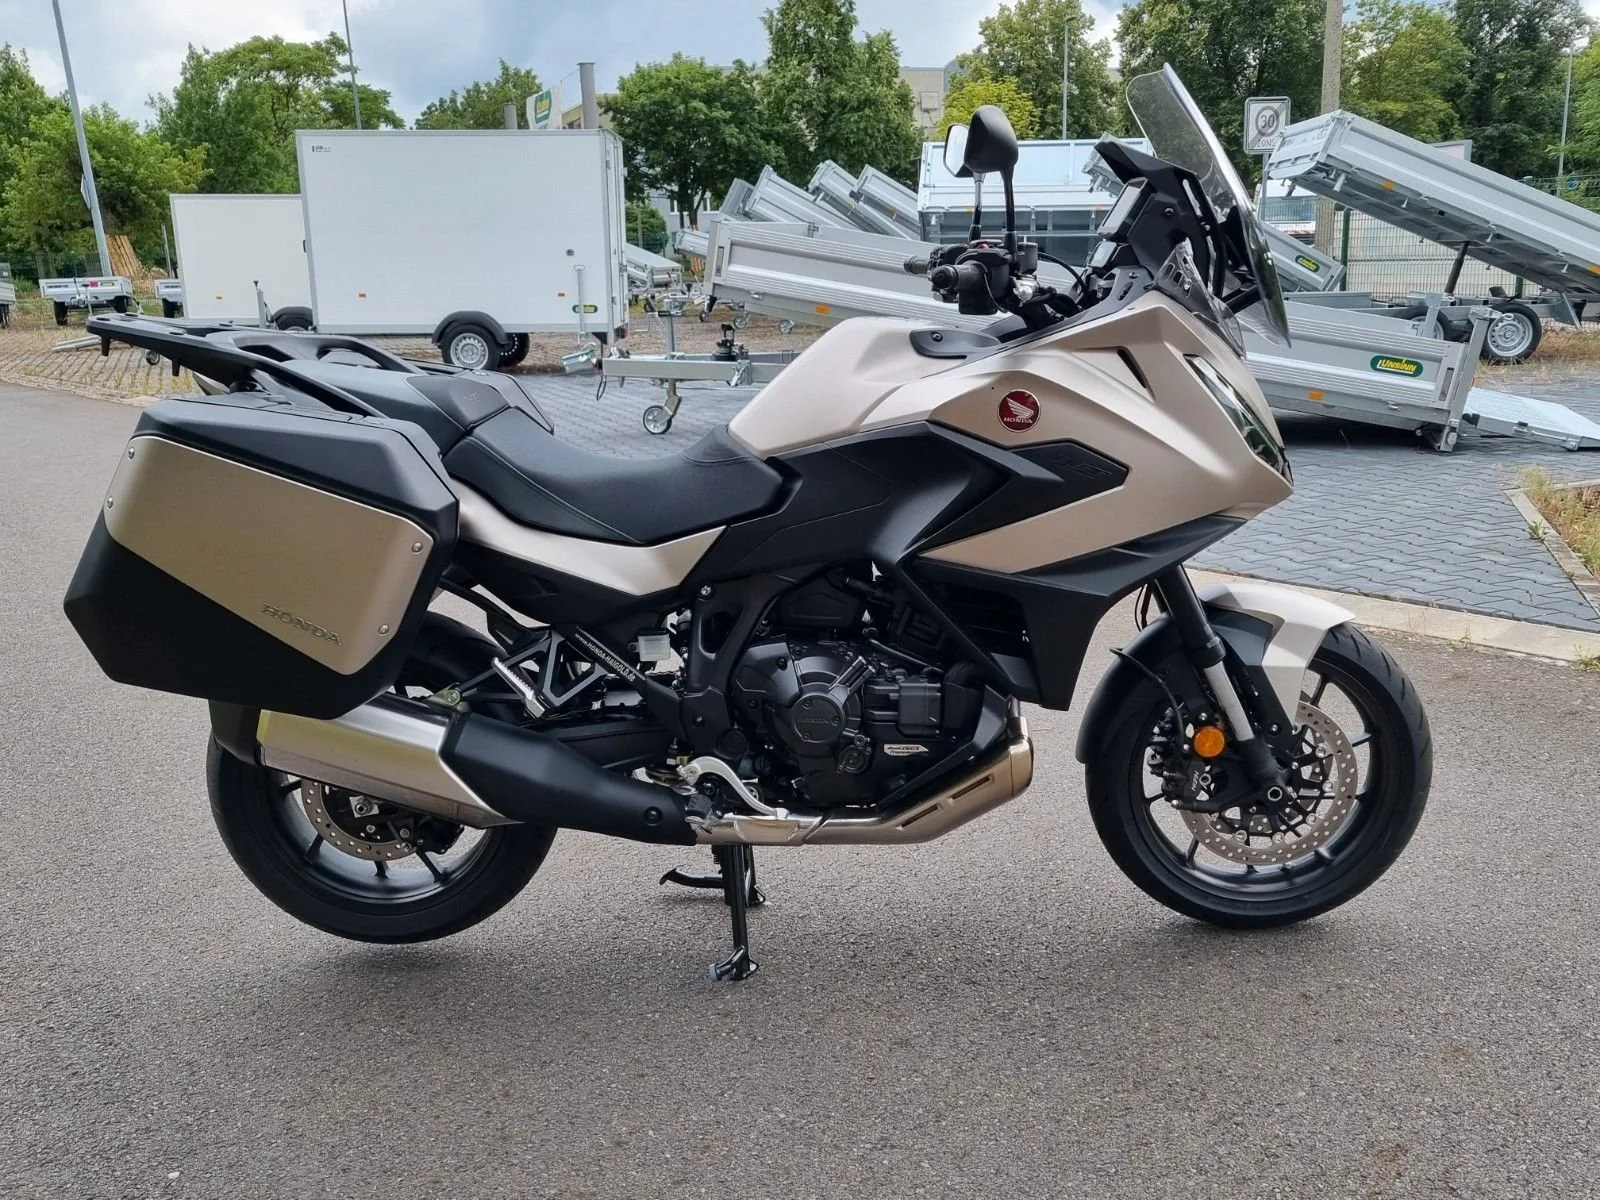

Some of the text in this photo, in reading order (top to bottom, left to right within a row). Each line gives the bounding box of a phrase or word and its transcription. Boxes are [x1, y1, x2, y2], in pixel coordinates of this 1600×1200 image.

[1260, 114, 1275, 129] 30
[1003, 416, 1033, 424] HONDA
[260, 602, 342, 646] HONDA
[575, 633, 636, 681] www.HONDA-HAIGOLD.de
